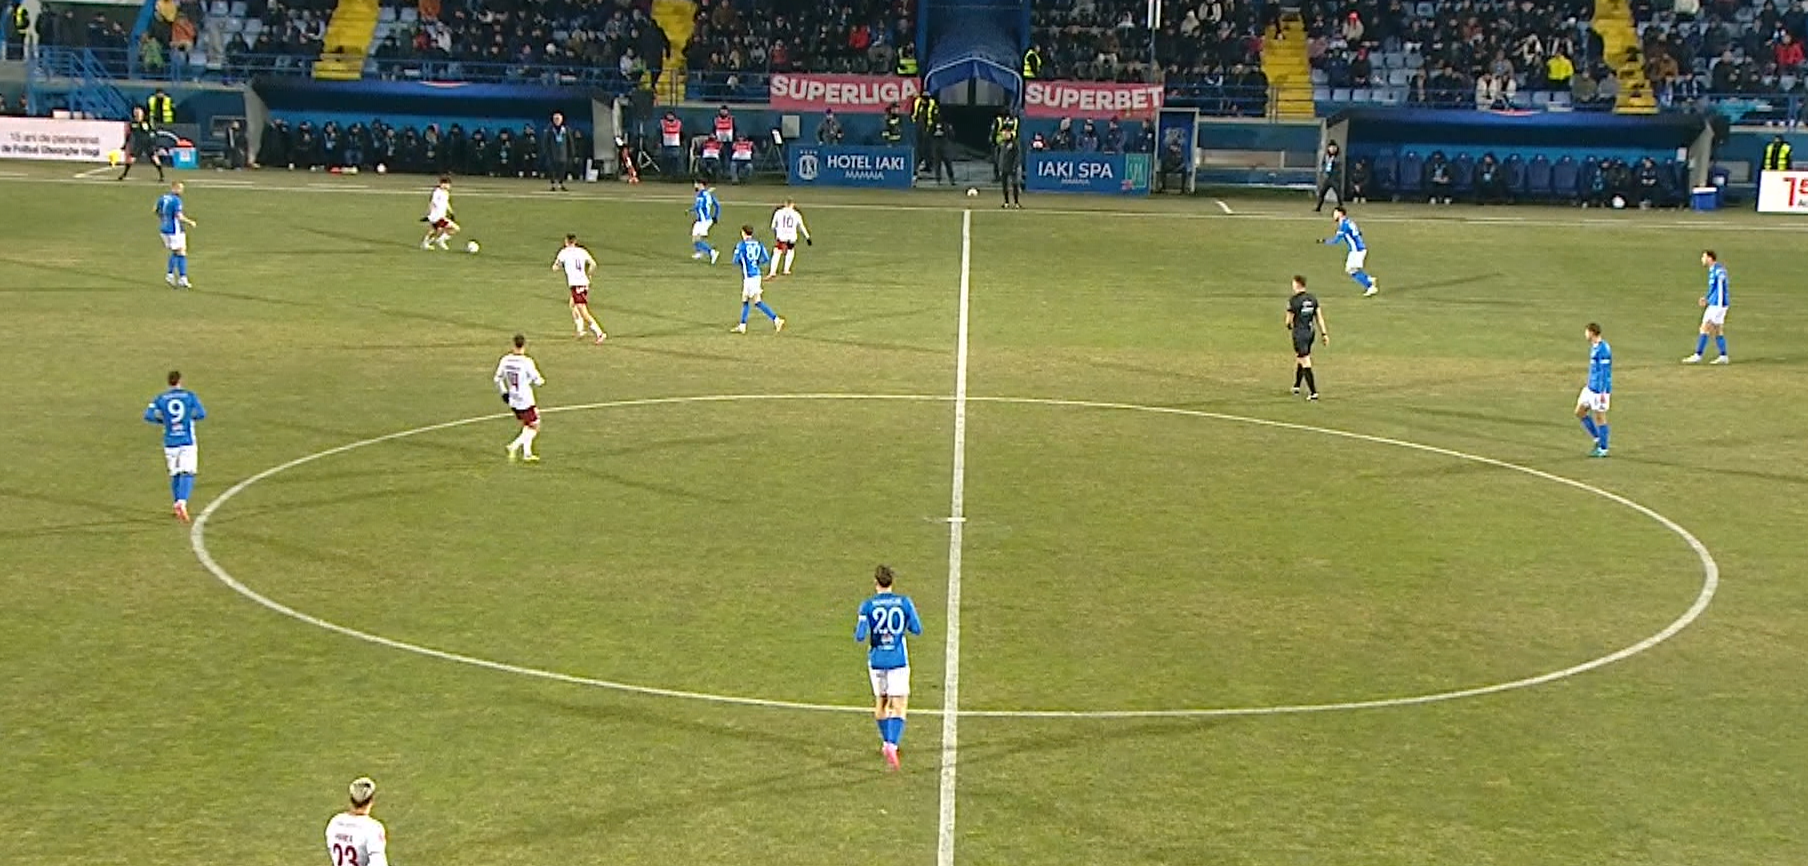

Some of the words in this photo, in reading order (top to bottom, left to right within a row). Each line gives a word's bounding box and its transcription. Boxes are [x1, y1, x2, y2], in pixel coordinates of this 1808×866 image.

[770, 75, 917, 104] SUPERLIGA
[1025, 83, 1164, 110] SUPERBET
[827, 155, 872, 169] HOTEL
[875, 156, 904, 171] IAKI
[1038, 161, 1074, 178] IAKI
[1078, 162, 1113, 179] SPA
[845, 170, 885, 180] MAMAIA
[782, 215, 794, 228] 10
[746, 244, 761, 260] 80
[168, 399, 185, 422] 9
[872, 606, 905, 634] 20
